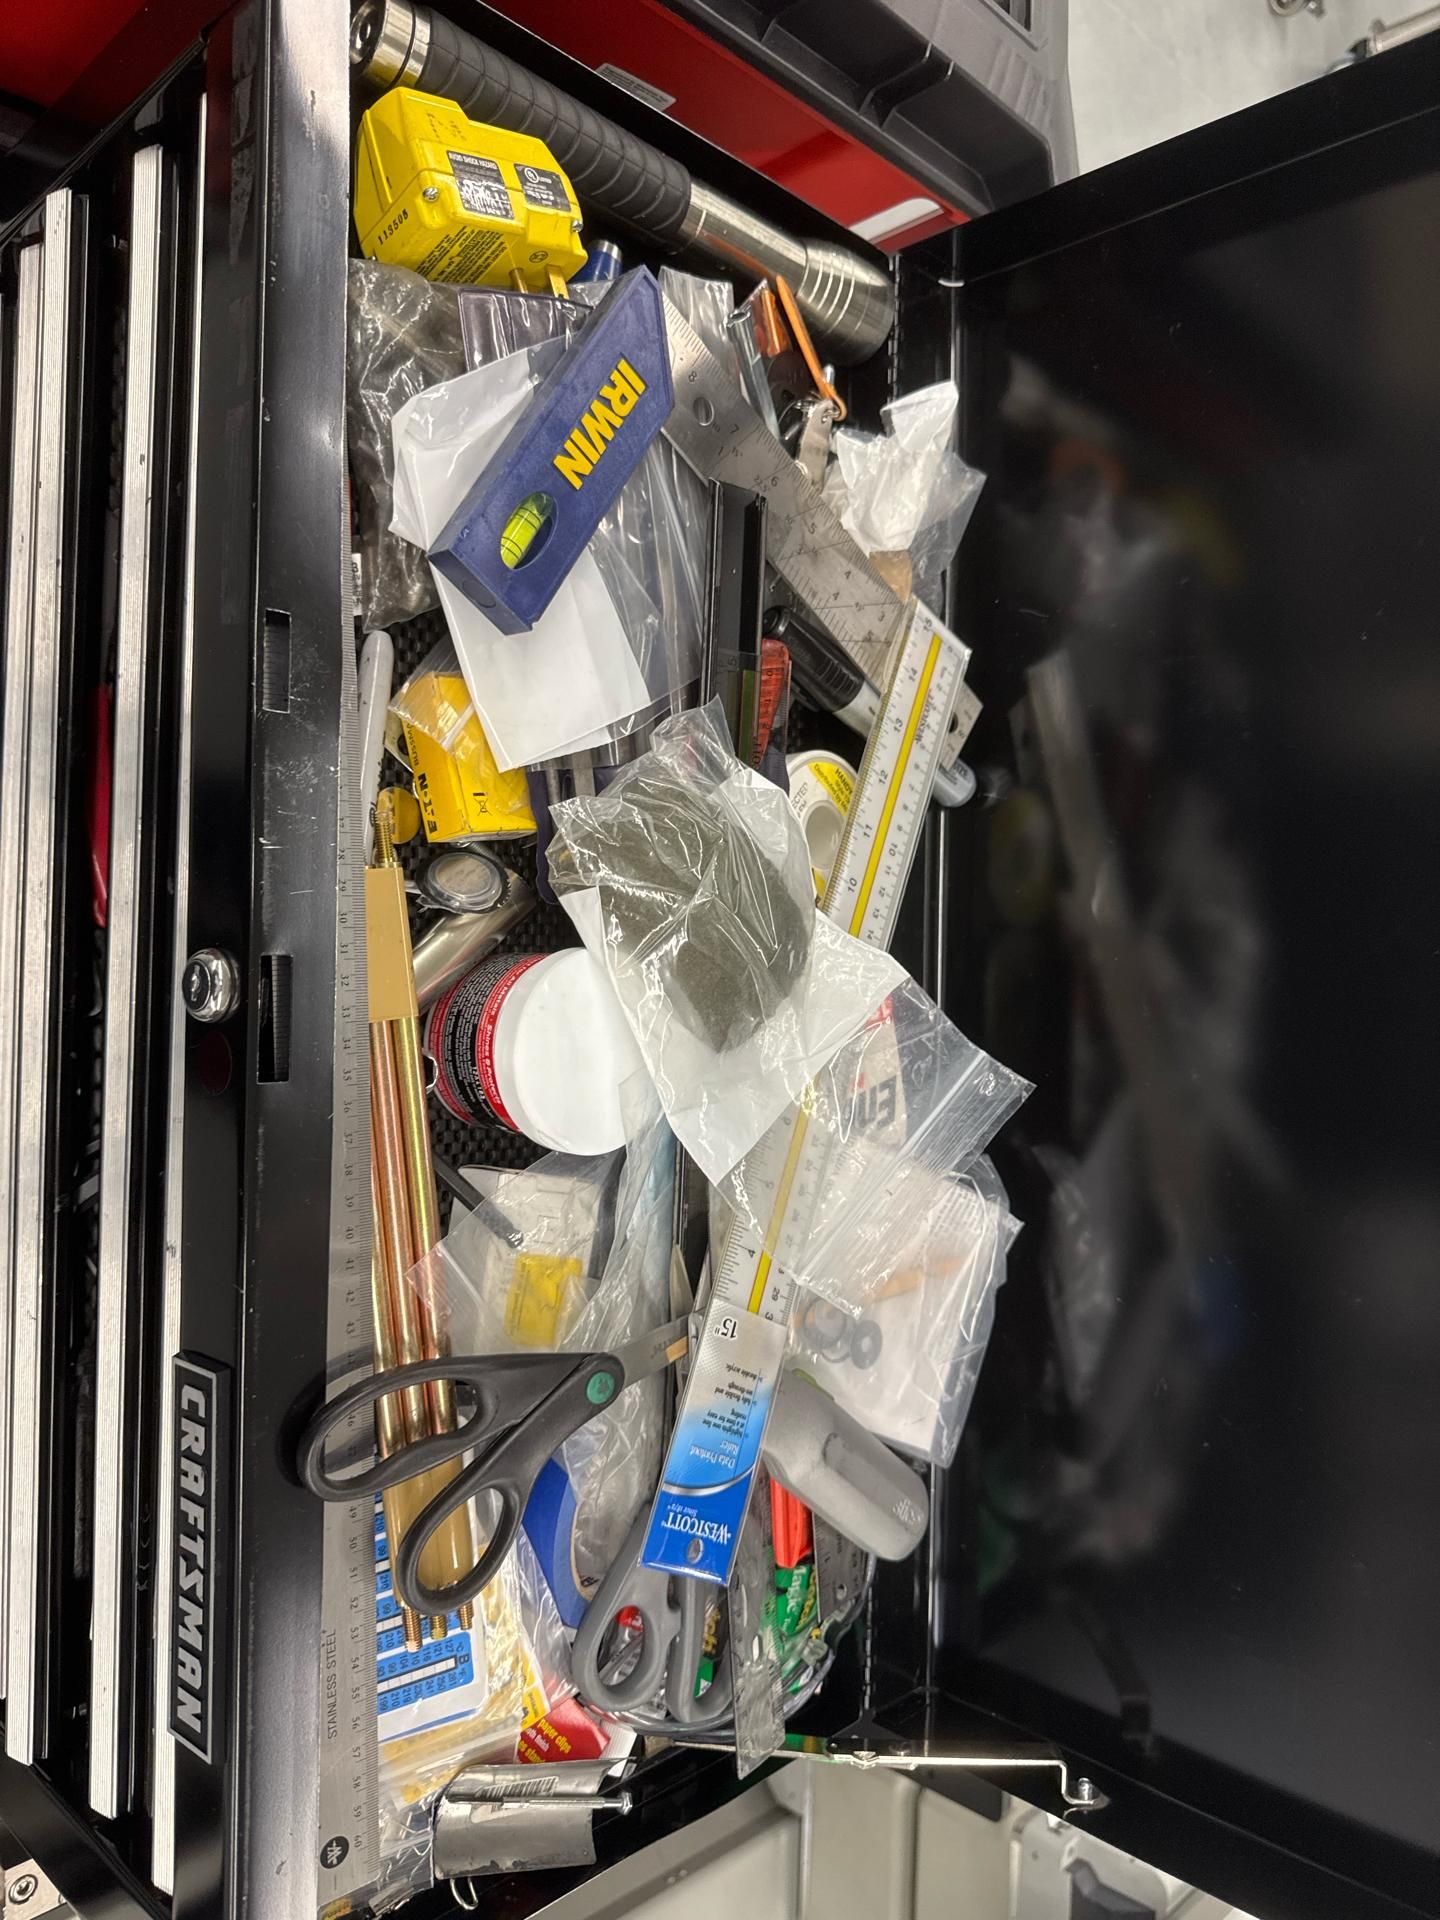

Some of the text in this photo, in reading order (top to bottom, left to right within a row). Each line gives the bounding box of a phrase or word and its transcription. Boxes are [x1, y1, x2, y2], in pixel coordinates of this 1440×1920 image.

[553, 356, 647, 491] IRWIN
[688, 371, 698, 382] 8
[771, 476, 780, 487] 6
[848, 617, 933, 893] 10 11 12 13 14 15
[889, 843, 898, 856] 10
[339, 880, 347, 892] 29
[340, 912, 348, 924] 30
[340, 942, 348, 954] 31
[340, 974, 350, 987] 32
[341, 1005, 351, 1018] 33
[342, 1037, 351, 1050] 34
[484, 1024, 493, 1056] Shines
[343, 1068, 352, 1082] 35
[486, 1065, 501, 1105] Protects
[343, 1101, 352, 1113] 36
[344, 1132, 353, 1144] 37
[344, 1163, 353, 1176] 38
[345, 1195, 354, 1208] 39
[345, 1226, 354, 1240] 40
[747, 1248, 756, 1259] 4
[345, 1257, 355, 1270] 41
[345, 1289, 355, 1303] 42
[771, 1286, 781, 1302] 29
[346, 1322, 355, 1335] 43
[720, 1440, 740, 1457] Ruler
[690, 1444, 736, 1470] Data Printout
[349, 1505, 358, 1519] 49
[662, 1511, 729, 1546] WESTCOTT
[349, 1537, 358, 1550] 50
[177, 1384, 206, 1734] CRAFTSMAN
[350, 1567, 358, 1579] 51
[380, 1573, 389, 1590] 210
[350, 1597, 359, 1610] 52
[383, 1603, 392, 1614] 99
[351, 1627, 359, 1640] 53
[385, 1632, 395, 1649] 210
[433, 1642, 443, 1656] 121
[445, 1639, 455, 1653] 127
[351, 1657, 360, 1670] 54
[400, 1654, 409, 1670] 104
[459, 1653, 470, 1665] B
[388, 1662, 398, 1674] 99
[326, 1629, 338, 1740] STAINLESS STEEL
[425, 1679, 435, 1694] 241
[351, 1686, 360, 1700] 55
[391, 1692, 401, 1707] 210
[402, 1687, 413, 1703] 219
[352, 1717, 361, 1730] 56
[537, 1718, 572, 1754] paper clips
[352, 1746, 361, 1759] 57
[352, 1776, 361, 1789] 58
[353, 1805, 362, 1819] 59
[354, 1834, 363, 1848] 60
